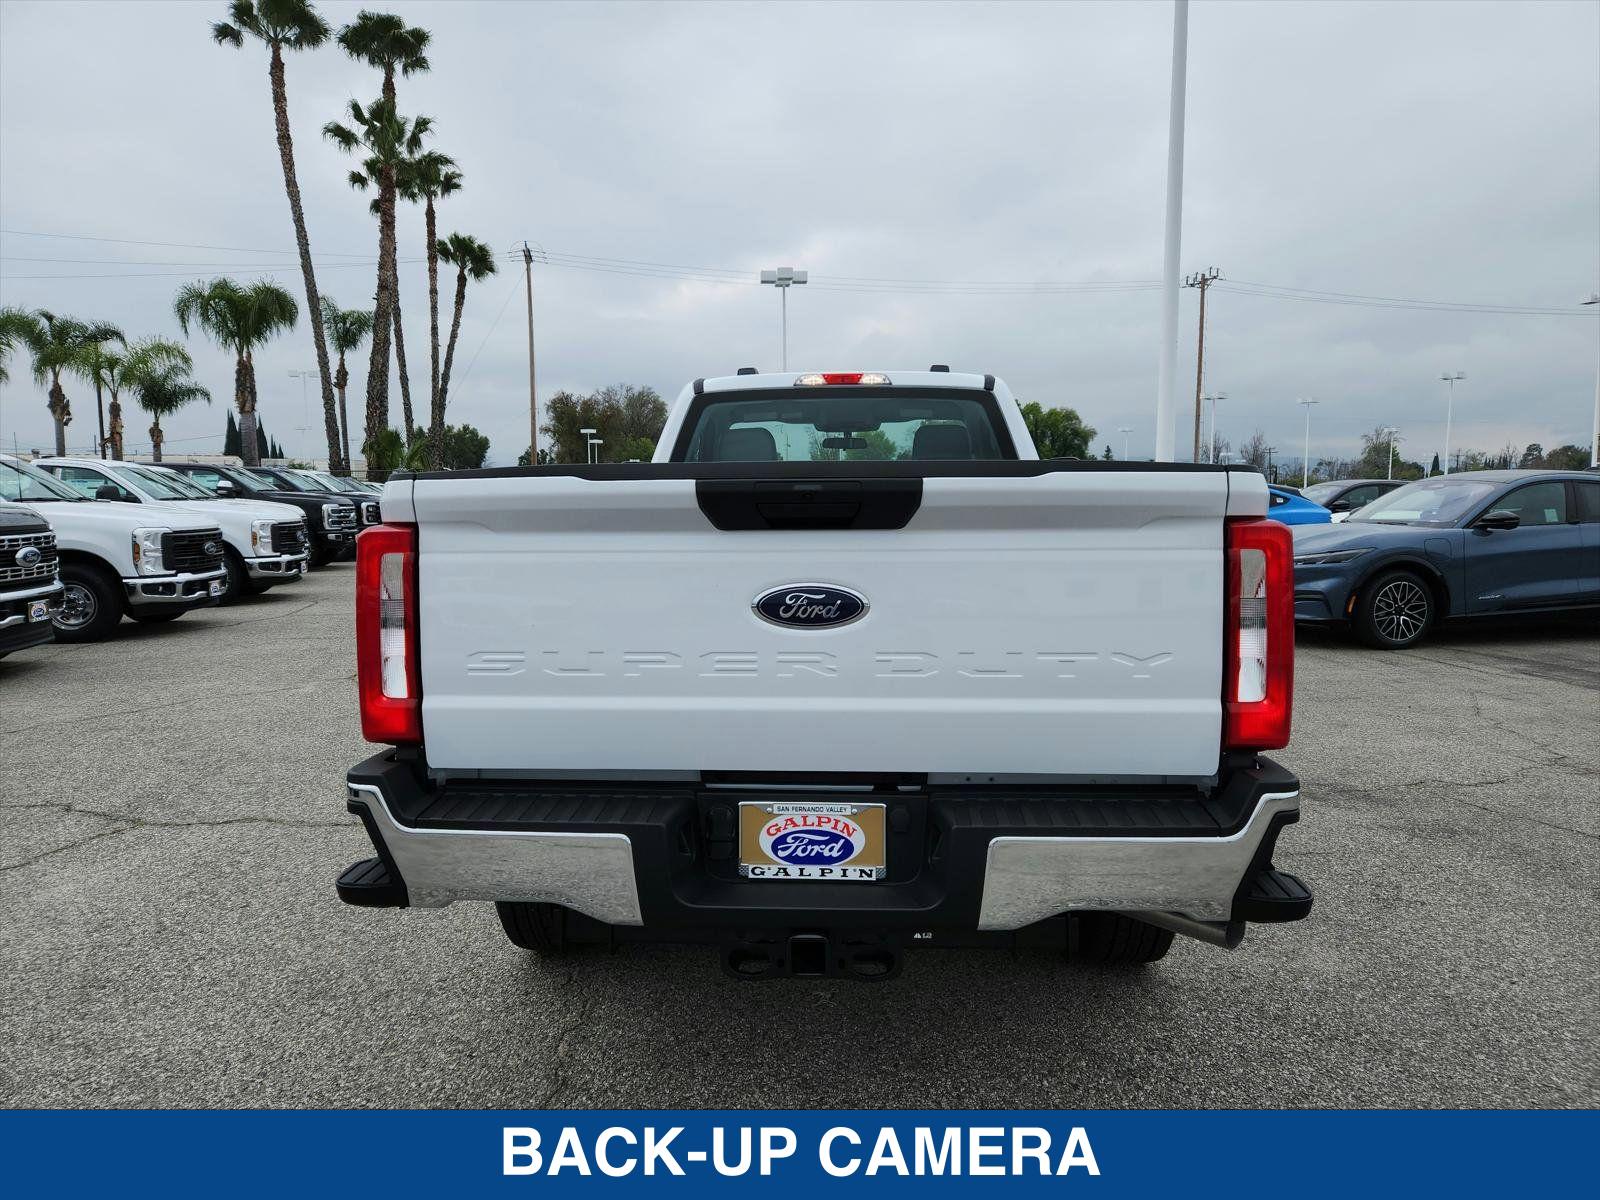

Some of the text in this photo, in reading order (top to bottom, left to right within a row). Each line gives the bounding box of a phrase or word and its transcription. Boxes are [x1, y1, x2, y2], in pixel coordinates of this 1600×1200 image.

[779, 592, 842, 618] Ford
[467, 651, 1174, 678] SUPER DUTY
[776, 805, 790, 813] SAN
[791, 805, 824, 813] FERNANDO
[766, 815, 858, 837] GALPIN
[777, 833, 845, 857] Ford
